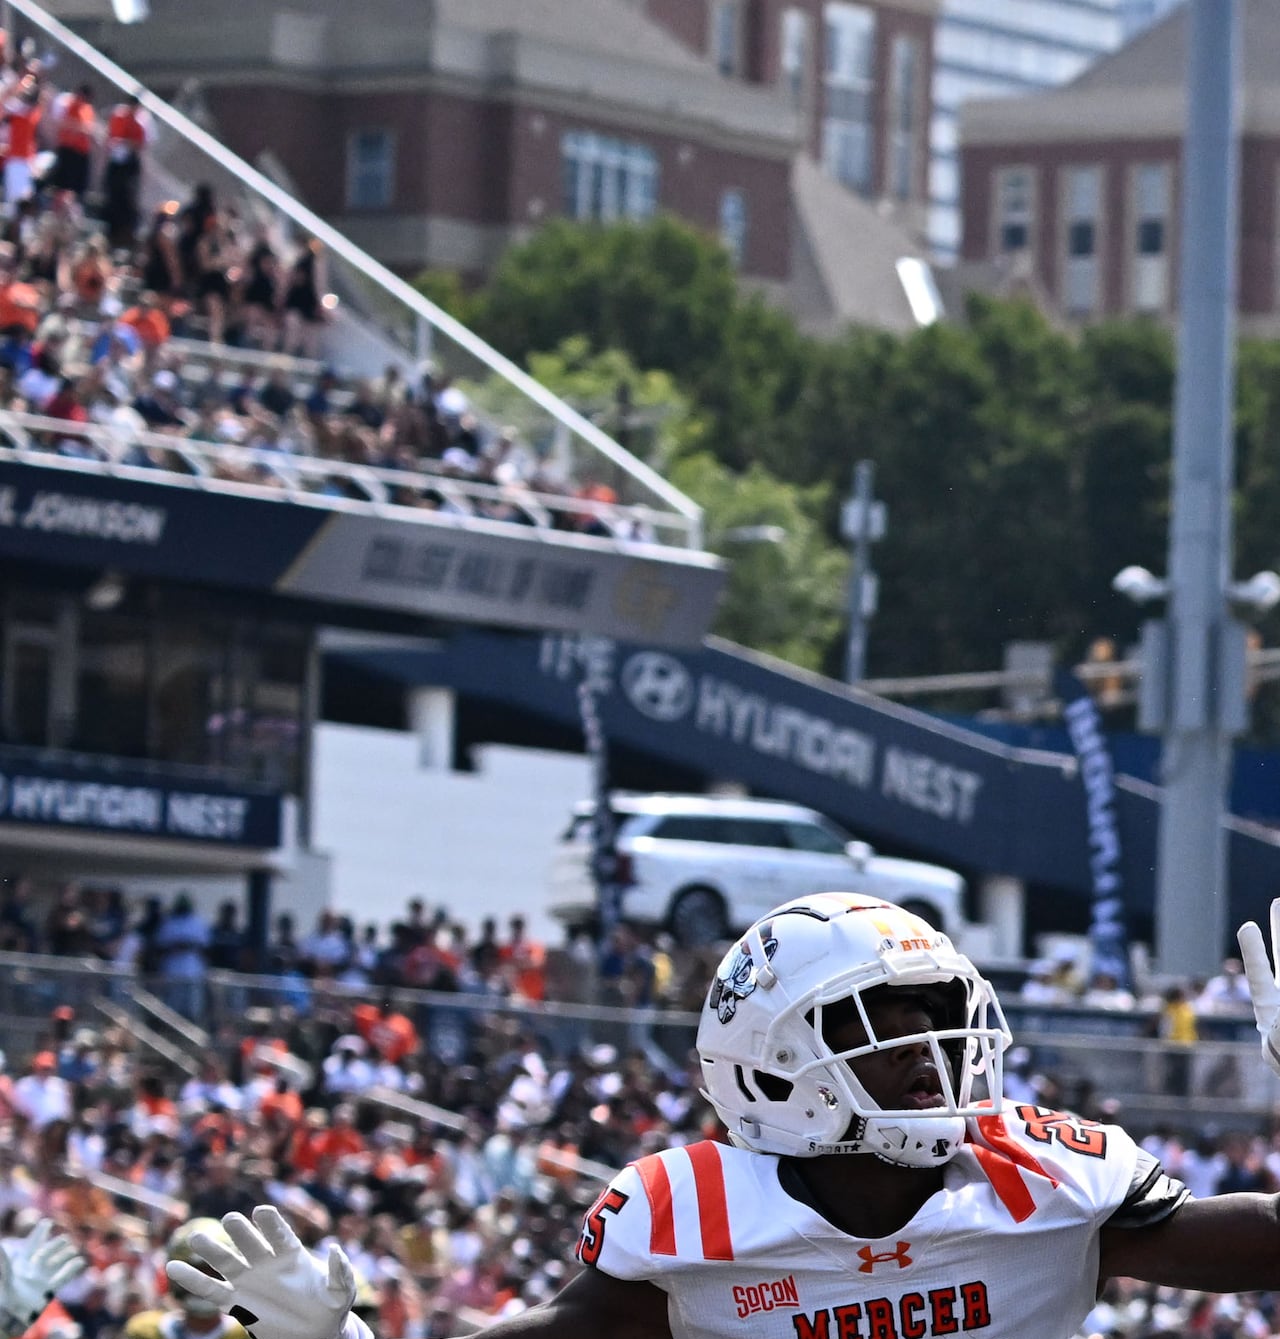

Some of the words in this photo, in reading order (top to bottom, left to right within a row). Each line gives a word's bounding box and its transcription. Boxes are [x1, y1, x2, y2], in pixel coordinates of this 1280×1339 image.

[22, 489, 168, 546] JOHNSON
[698, 674, 877, 789] HYUNDAI
[882, 747, 984, 827] NEST
[11, 775, 163, 832] HYUNDAI
[167, 791, 247, 839] NEST
